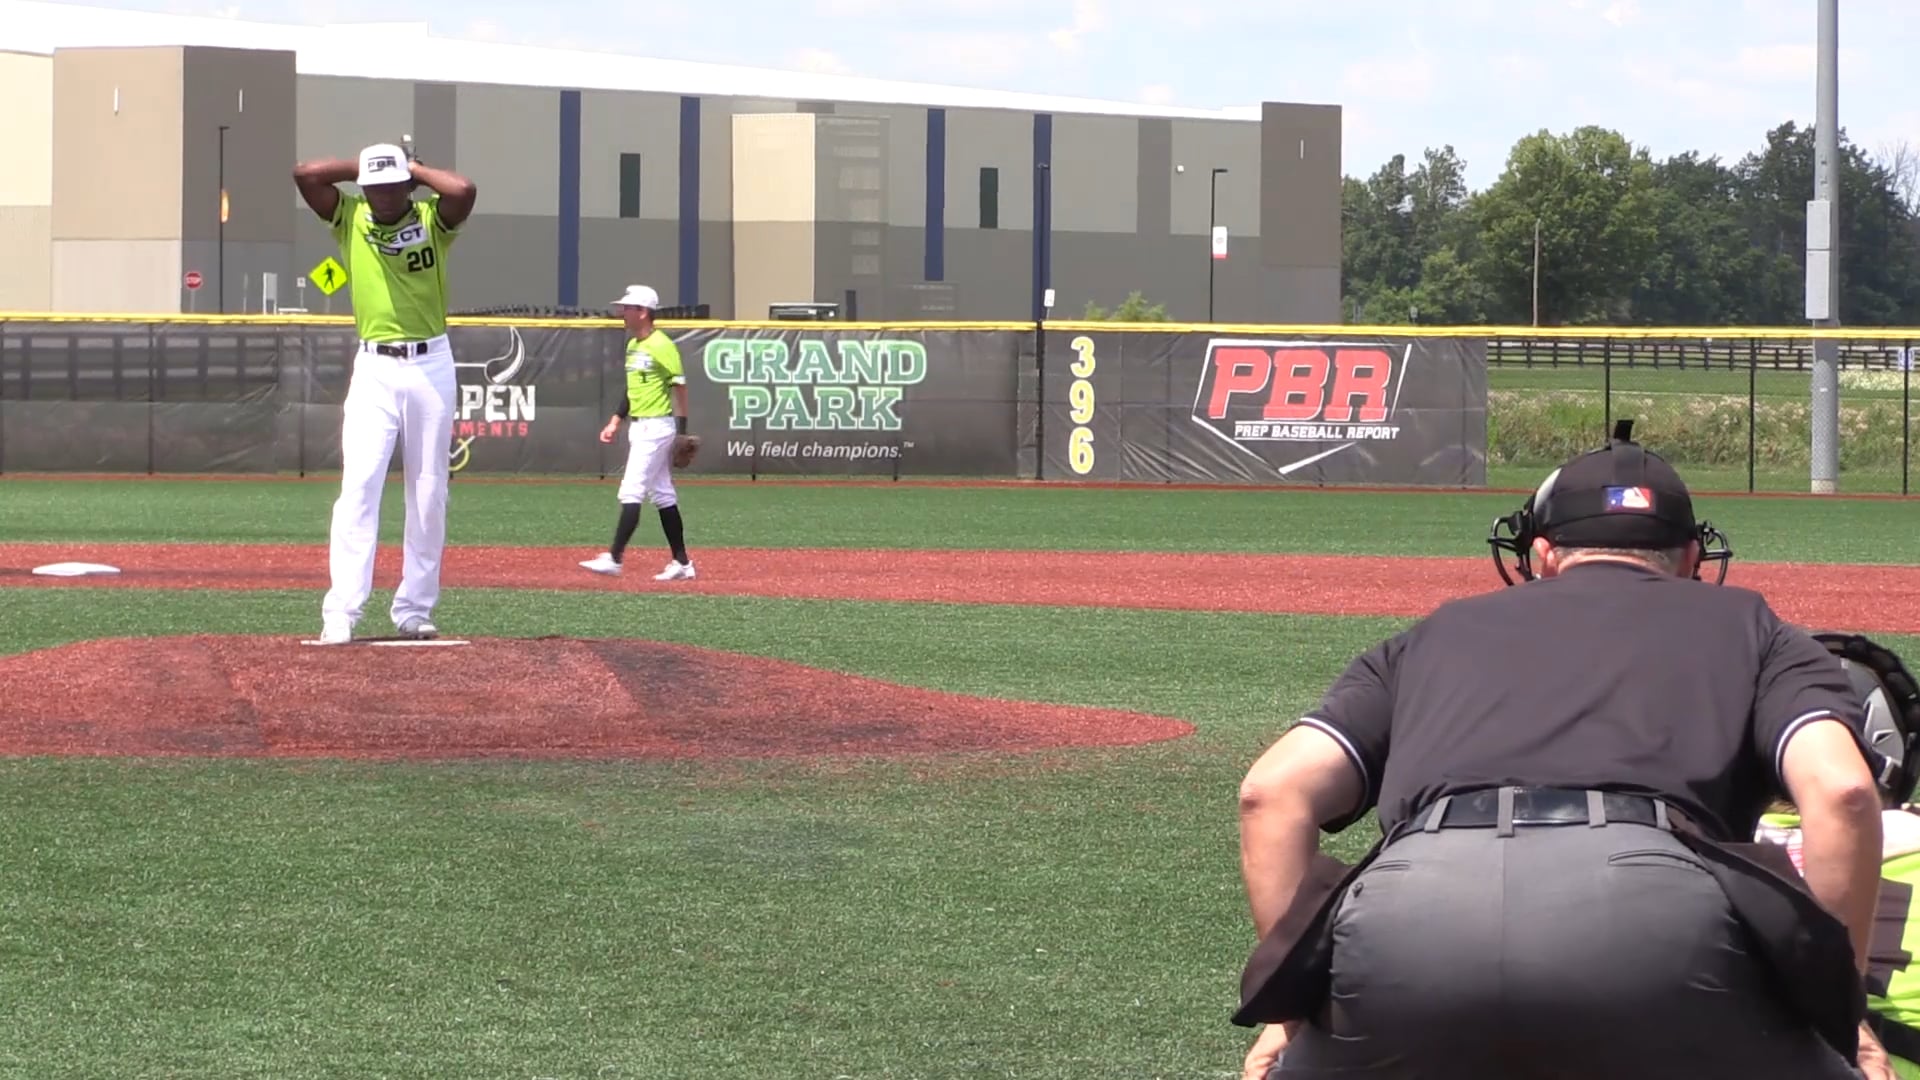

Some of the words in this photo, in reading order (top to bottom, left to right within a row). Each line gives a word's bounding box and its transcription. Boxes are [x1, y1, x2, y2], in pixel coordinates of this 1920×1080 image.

[407, 246, 434, 272] 20
[704, 339, 927, 384] GRAND
[454, 384, 536, 422] PEN
[1208, 348, 1392, 422] PBR
[728, 386, 903, 430] PARK
[727, 441, 755, 457] We
[760, 441, 798, 457] field
[1234, 425, 1268, 437] PREP
[1271, 425, 1343, 439] BASEBALL
[1346, 427, 1400, 440] REPORT
